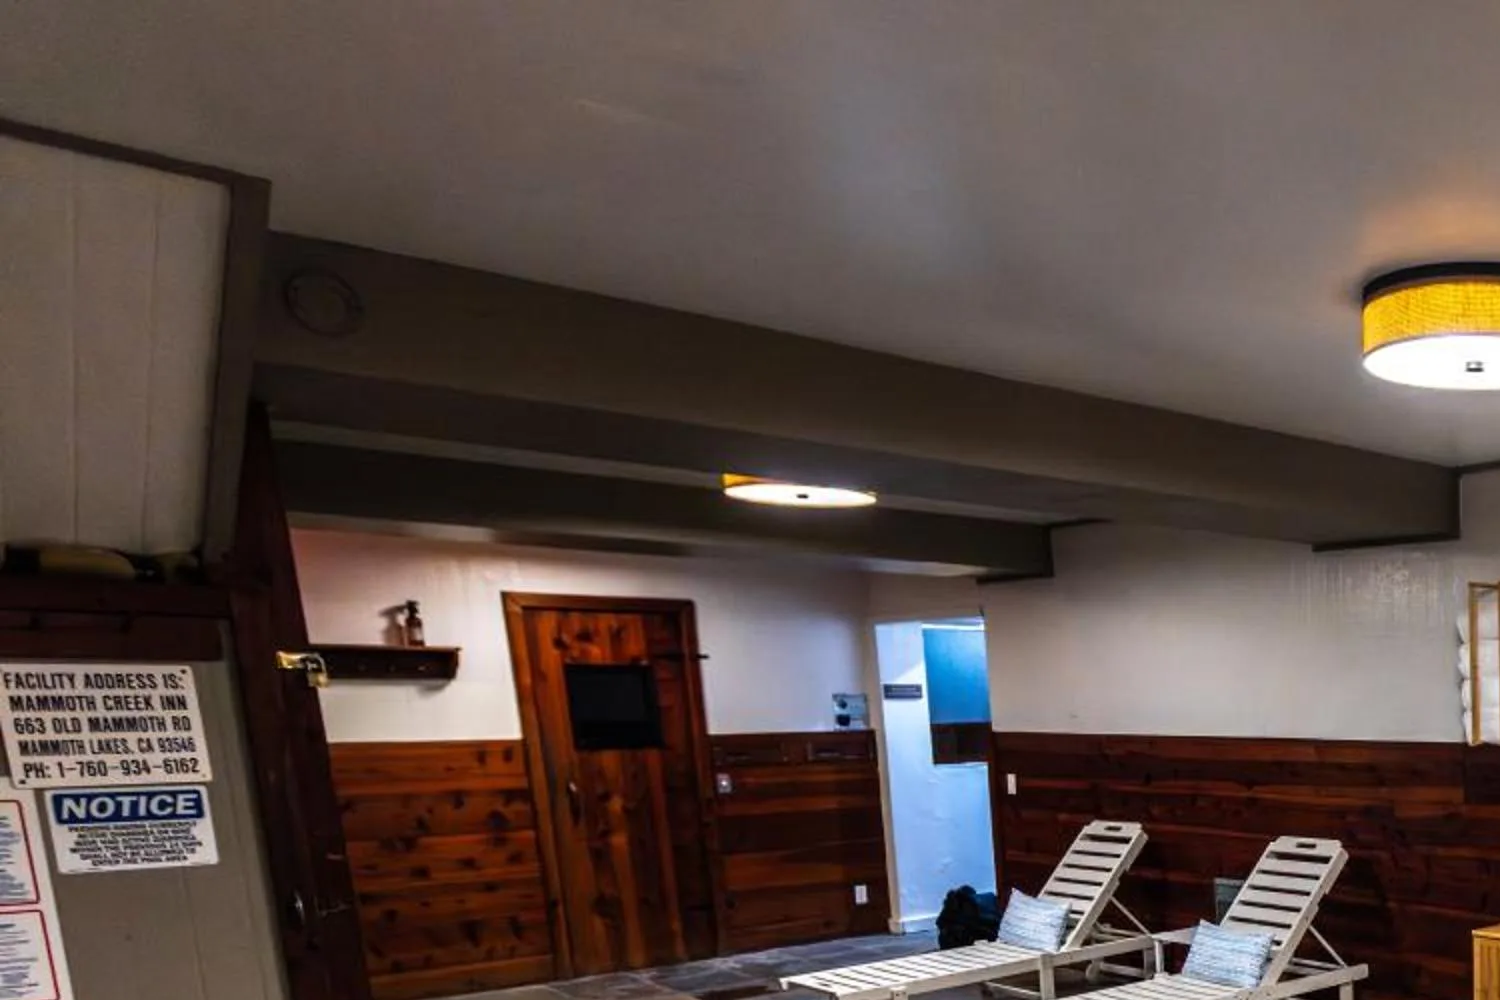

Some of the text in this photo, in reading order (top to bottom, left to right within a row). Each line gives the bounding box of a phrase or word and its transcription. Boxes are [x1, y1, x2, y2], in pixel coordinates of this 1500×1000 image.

[3, 672, 185, 690] FACILITY ADDRESS IS:
[8, 694, 188, 713] MAMMOTH CREEK INN
[13, 716, 192, 735] 663 OLD MAMMOTH RD
[17, 739, 87, 757] MAMMOTH
[137, 738, 155, 754] CA
[157, 737, 197, 753] 93546
[22, 757, 200, 779] PH: 1-760-934-6162
[60, 793, 198, 820] NOTICE
